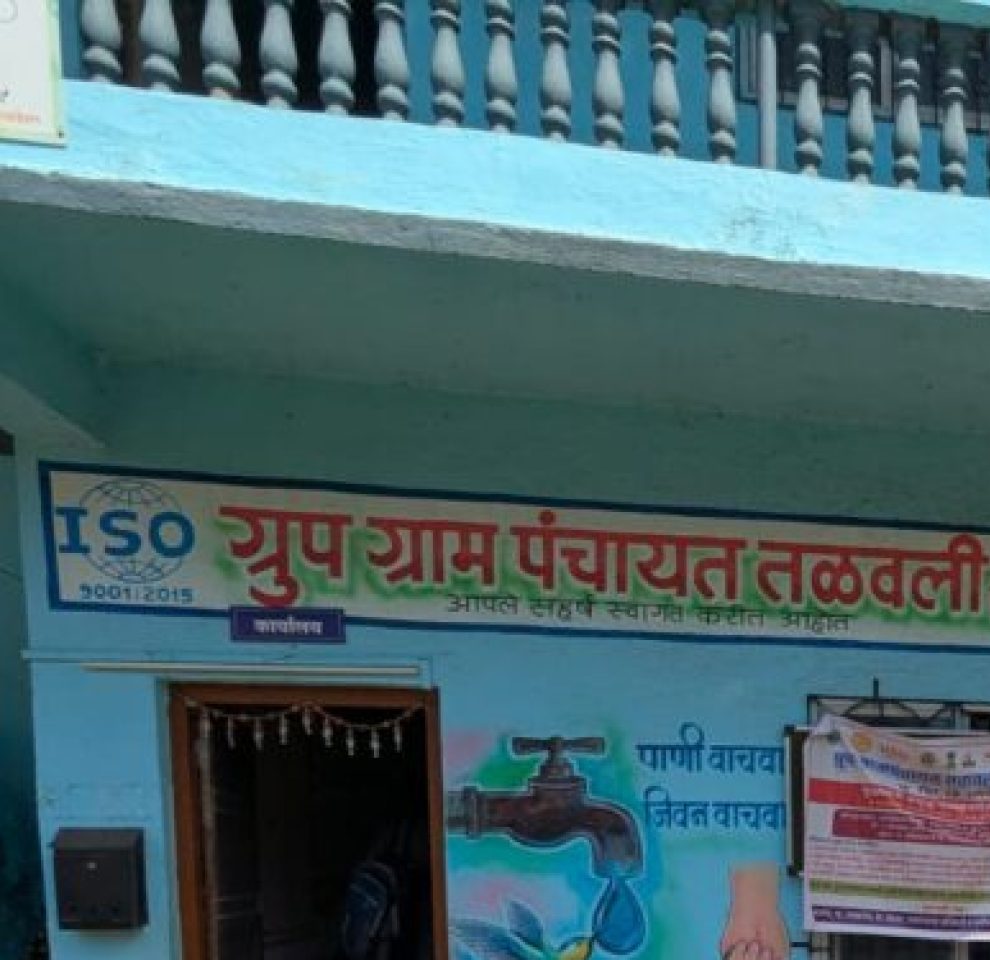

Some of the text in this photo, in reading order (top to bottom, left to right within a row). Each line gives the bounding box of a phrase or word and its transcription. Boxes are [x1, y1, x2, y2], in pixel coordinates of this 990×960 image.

[55, 506, 196, 559] ISO
[219, 506, 352, 608] ग्रुप
[366, 516, 499, 586] ग्राम
[510, 510, 746, 601] पंचायत
[757, 532, 990, 613] तळवली
[635, 722, 785, 775] पाणी वाचवा
[711, 801, 787, 830] वाचवा
